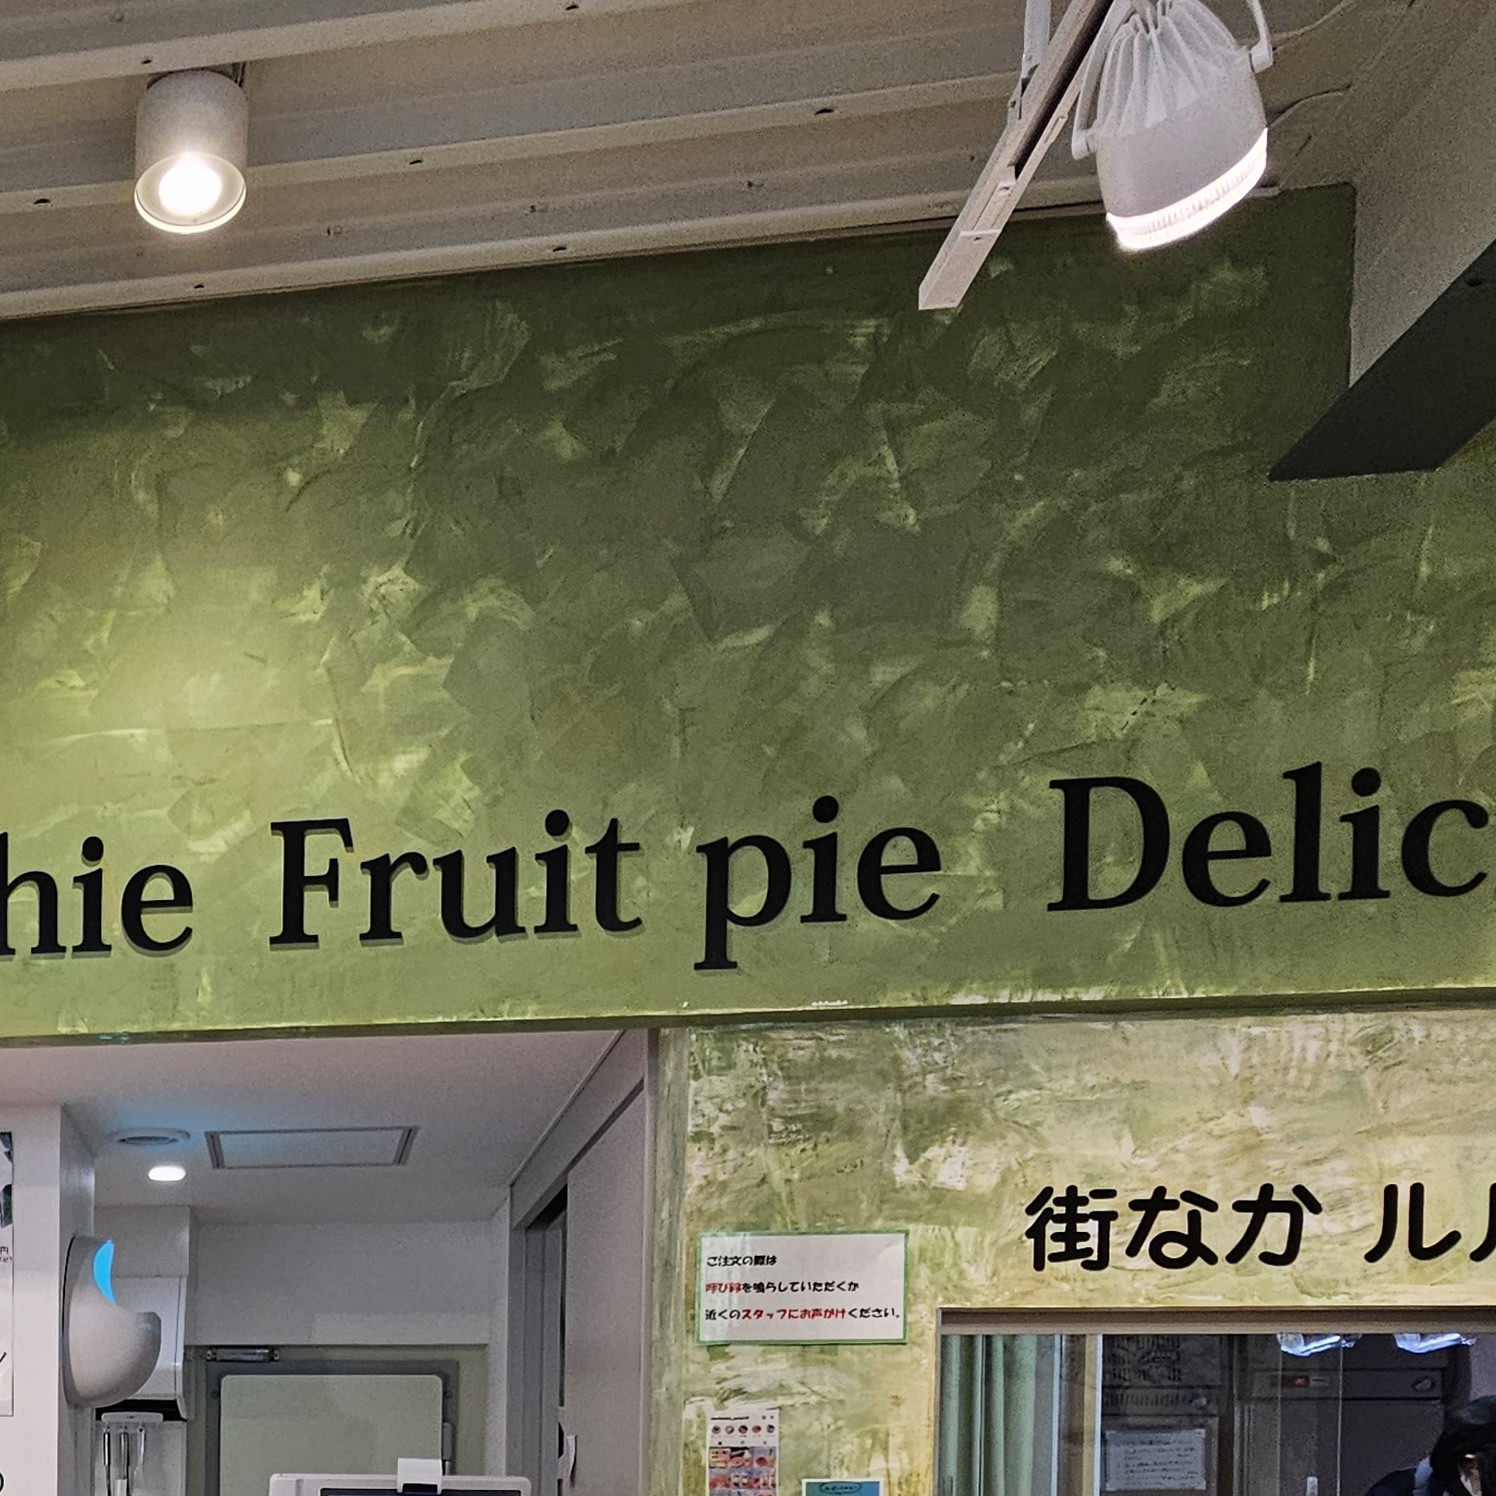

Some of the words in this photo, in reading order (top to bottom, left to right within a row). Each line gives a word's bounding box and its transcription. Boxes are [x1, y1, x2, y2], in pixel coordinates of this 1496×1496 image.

[270, 808, 642, 952] Fruit
[694, 795, 942, 971] pie
[1024, 1183, 1323, 1272] 街なか
[706, 1255, 777, 1267] ご注文の際は
[705, 1307, 901, 1321] 近くのスタッフにお声がけください。
